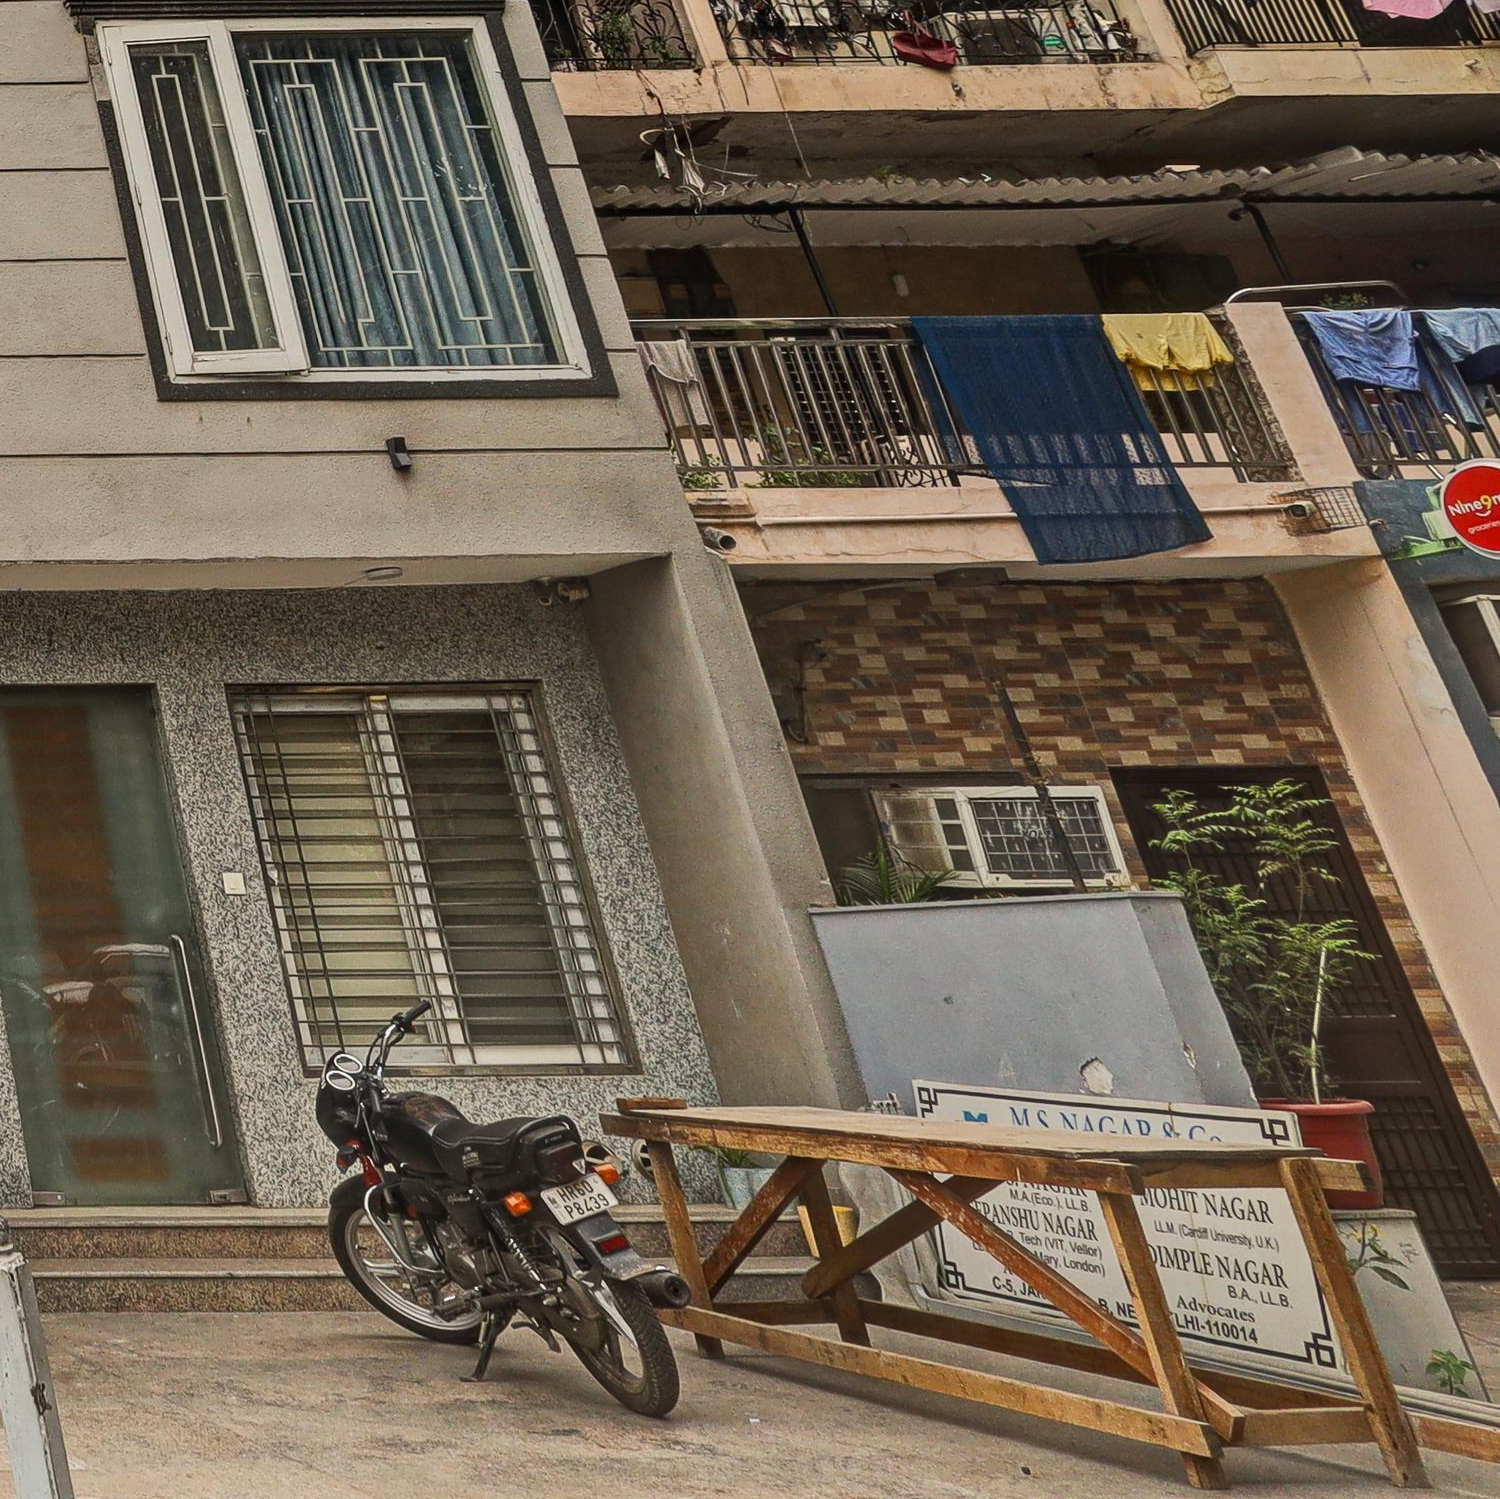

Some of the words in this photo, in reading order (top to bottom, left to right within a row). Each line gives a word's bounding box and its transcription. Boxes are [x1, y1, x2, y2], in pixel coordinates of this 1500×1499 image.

[556, 1180, 595, 1204] HR60
[564, 1194, 610, 1219] P8439
[1202, 1192, 1275, 1224] NAGAR
[1041, 1211, 1099, 1242] NAGAR
[1063, 1257, 1107, 1278] London)
[1215, 1255, 1290, 1289] NAGAR
[992, 1275, 1018, 1296] C-5,
[1177, 1294, 1256, 1323] Advocates
